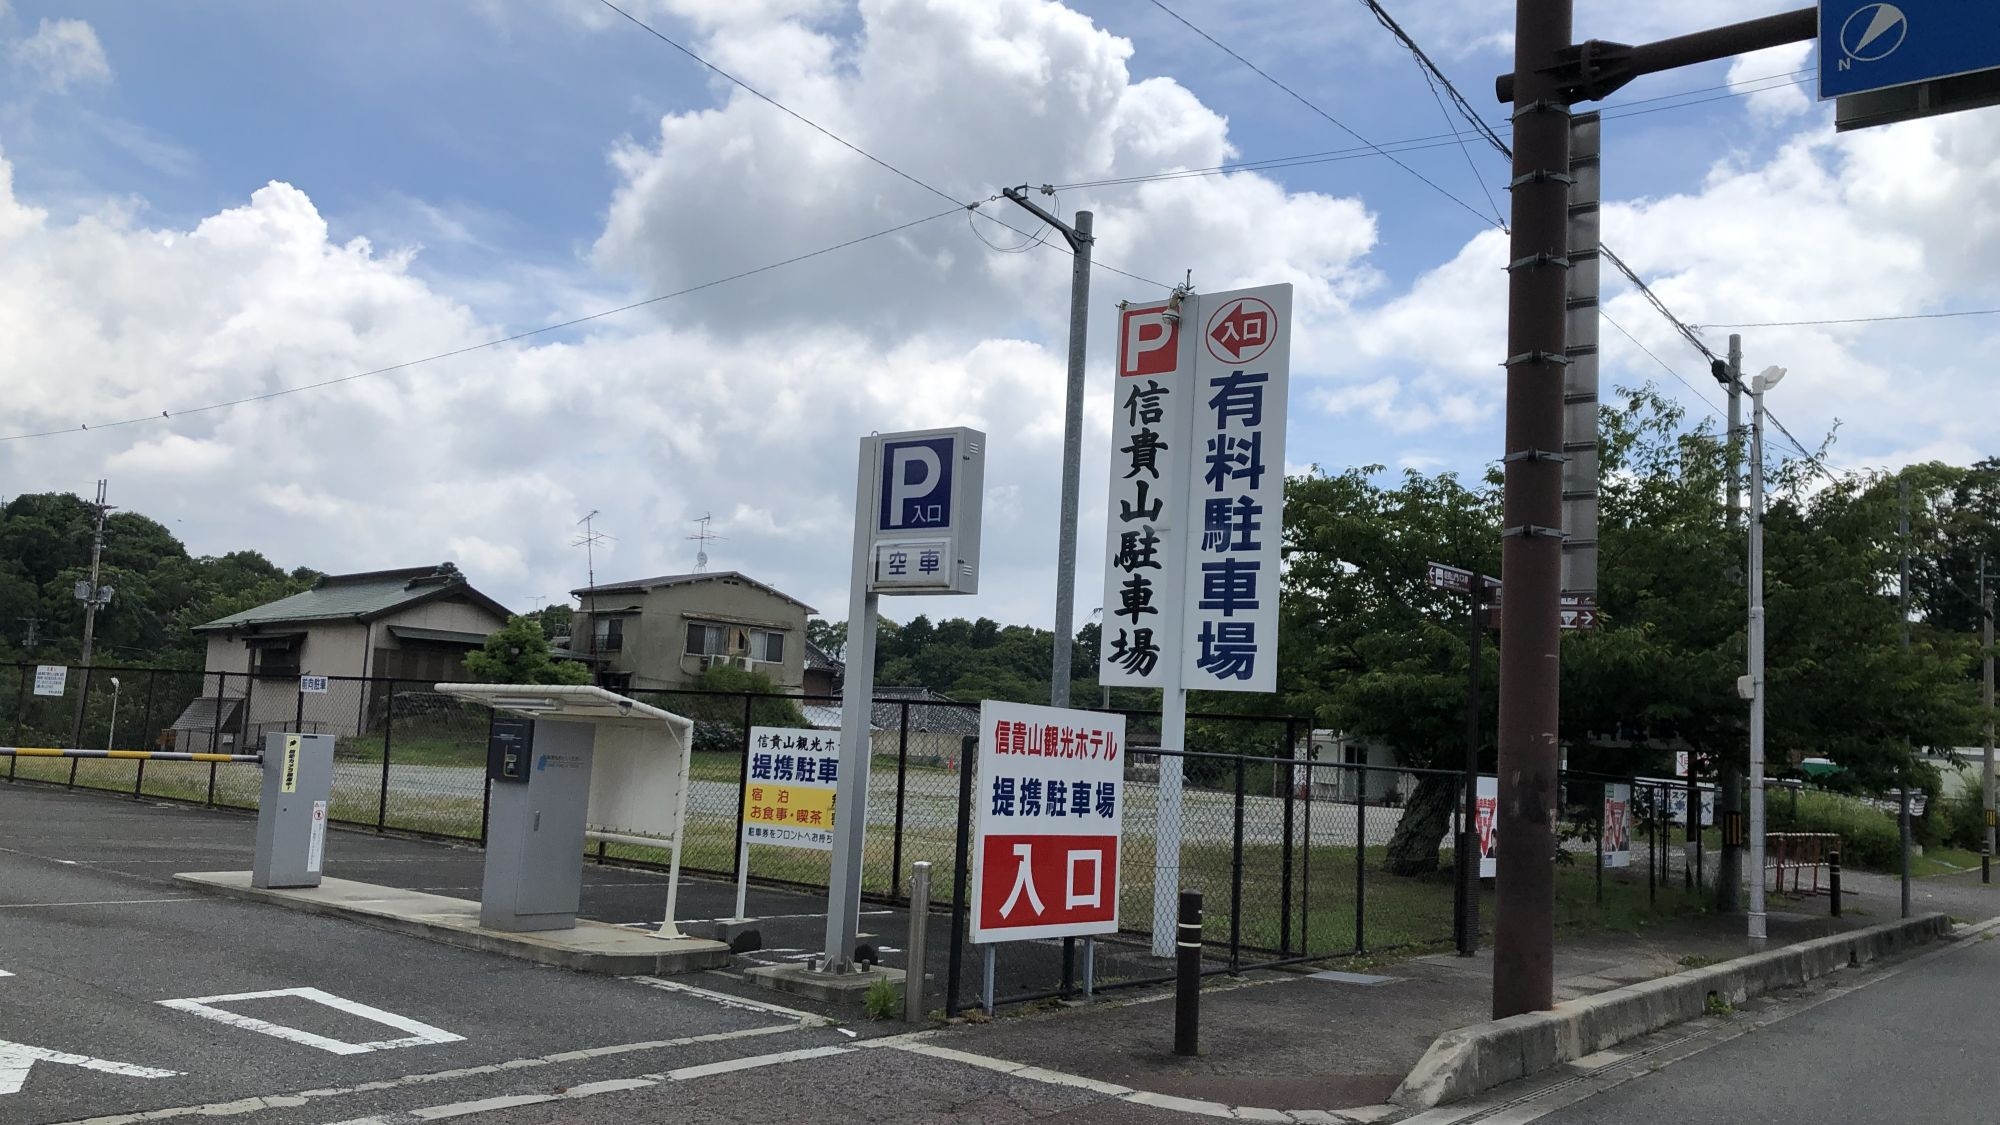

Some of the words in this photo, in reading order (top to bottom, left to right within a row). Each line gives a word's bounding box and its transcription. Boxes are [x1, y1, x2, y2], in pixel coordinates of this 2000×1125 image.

[1838, 57, 1851, 72] N
[1126, 312, 1172, 373] P
[1220, 318, 1262, 344] 入口
[889, 445, 942, 527] P
[911, 504, 942, 524] 入口
[1107, 379, 1170, 678] 信貴山駐車場
[1196, 370, 1269, 681] 有料駐車場
[888, 548, 940, 576] 空車
[757, 733, 841, 752] 信貴山観光ホ
[994, 719, 1118, 762] 信貴山観光ホテル
[991, 775, 1116, 819] 提携駐車場
[750, 805, 823, 825] お食事・喫茶
[747, 826, 833, 844] 駐車券をフロントへお持ち
[998, 842, 1103, 919] 入口
